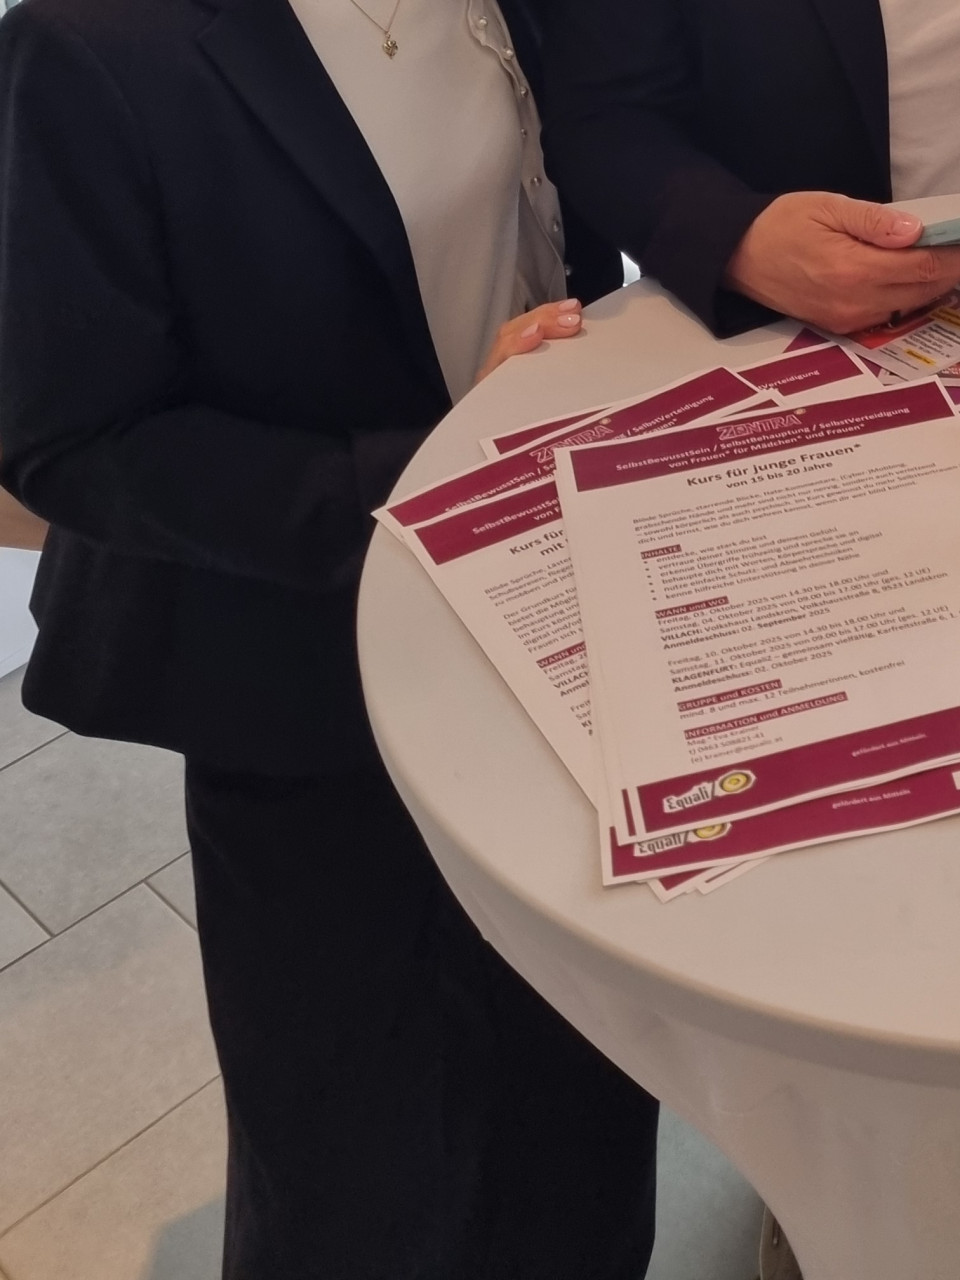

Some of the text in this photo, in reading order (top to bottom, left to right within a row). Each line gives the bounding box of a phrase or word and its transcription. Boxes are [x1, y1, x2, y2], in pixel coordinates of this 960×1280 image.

[685, 472, 723, 487] Kurs
[725, 466, 750, 479] für
[751, 456, 798, 473] junge
[725, 460, 834, 489] von 15 bis 20 Jahre
[508, 527, 565, 556] Kurs für
[538, 540, 565, 556] mit
[678, 695, 719, 710] GRUPPE
[719, 690, 739, 701] und
[684, 714, 758, 738] INFORMATION
[758, 709, 779, 720] und
